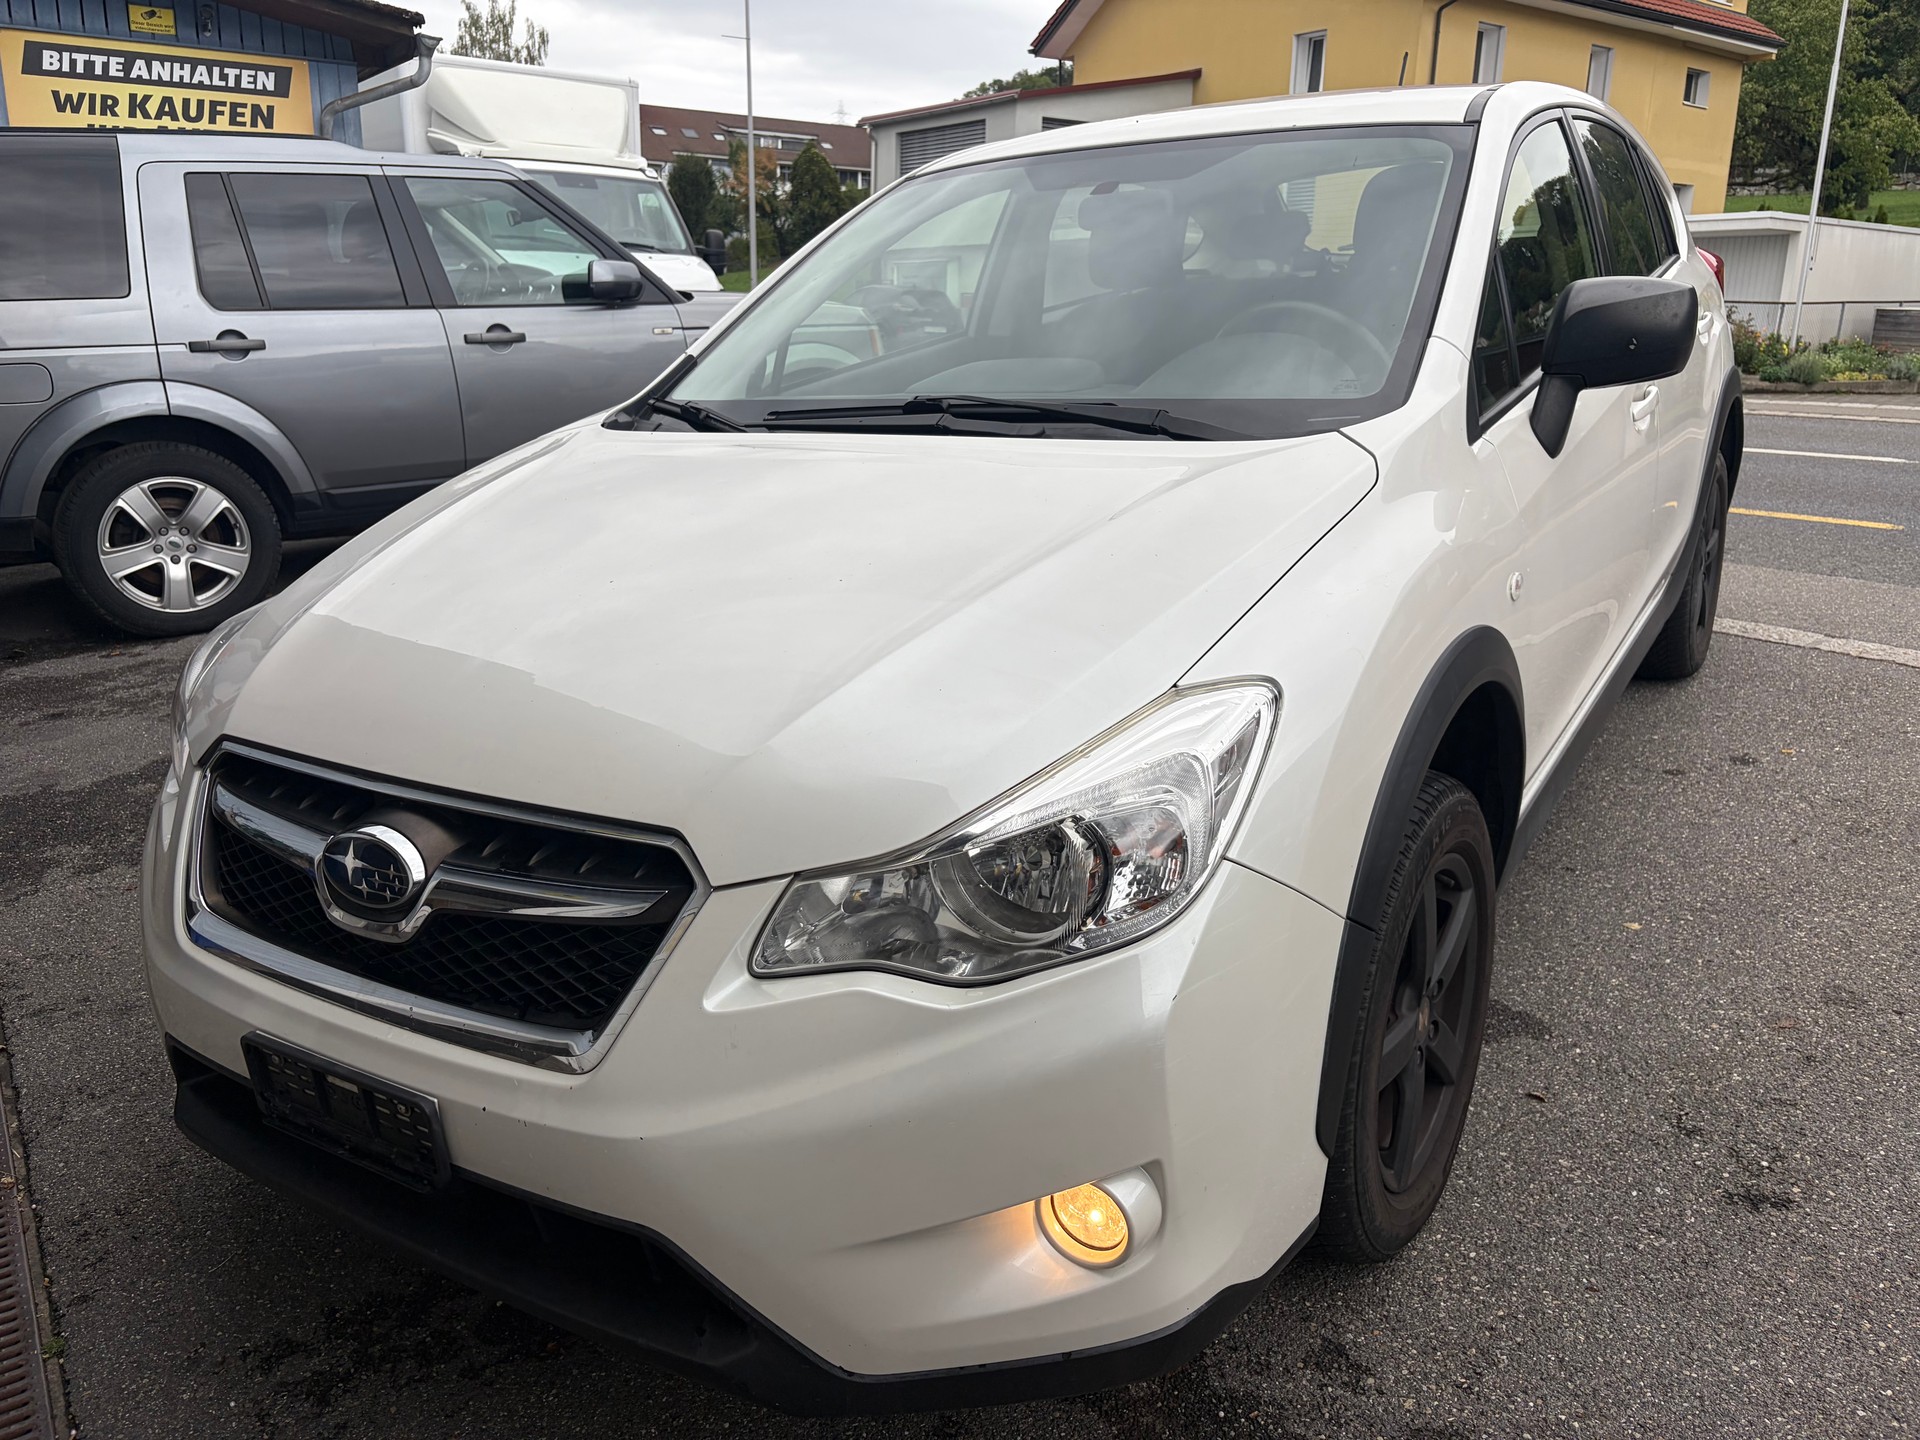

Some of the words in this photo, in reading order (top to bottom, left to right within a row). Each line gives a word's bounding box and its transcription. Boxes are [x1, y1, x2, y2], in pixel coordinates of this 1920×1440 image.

[42, 50, 124, 77] BITTE
[130, 58, 275, 91] ANHALTEN
[51, 90, 120, 117] WIR
[128, 93, 274, 130] KAUFEN
